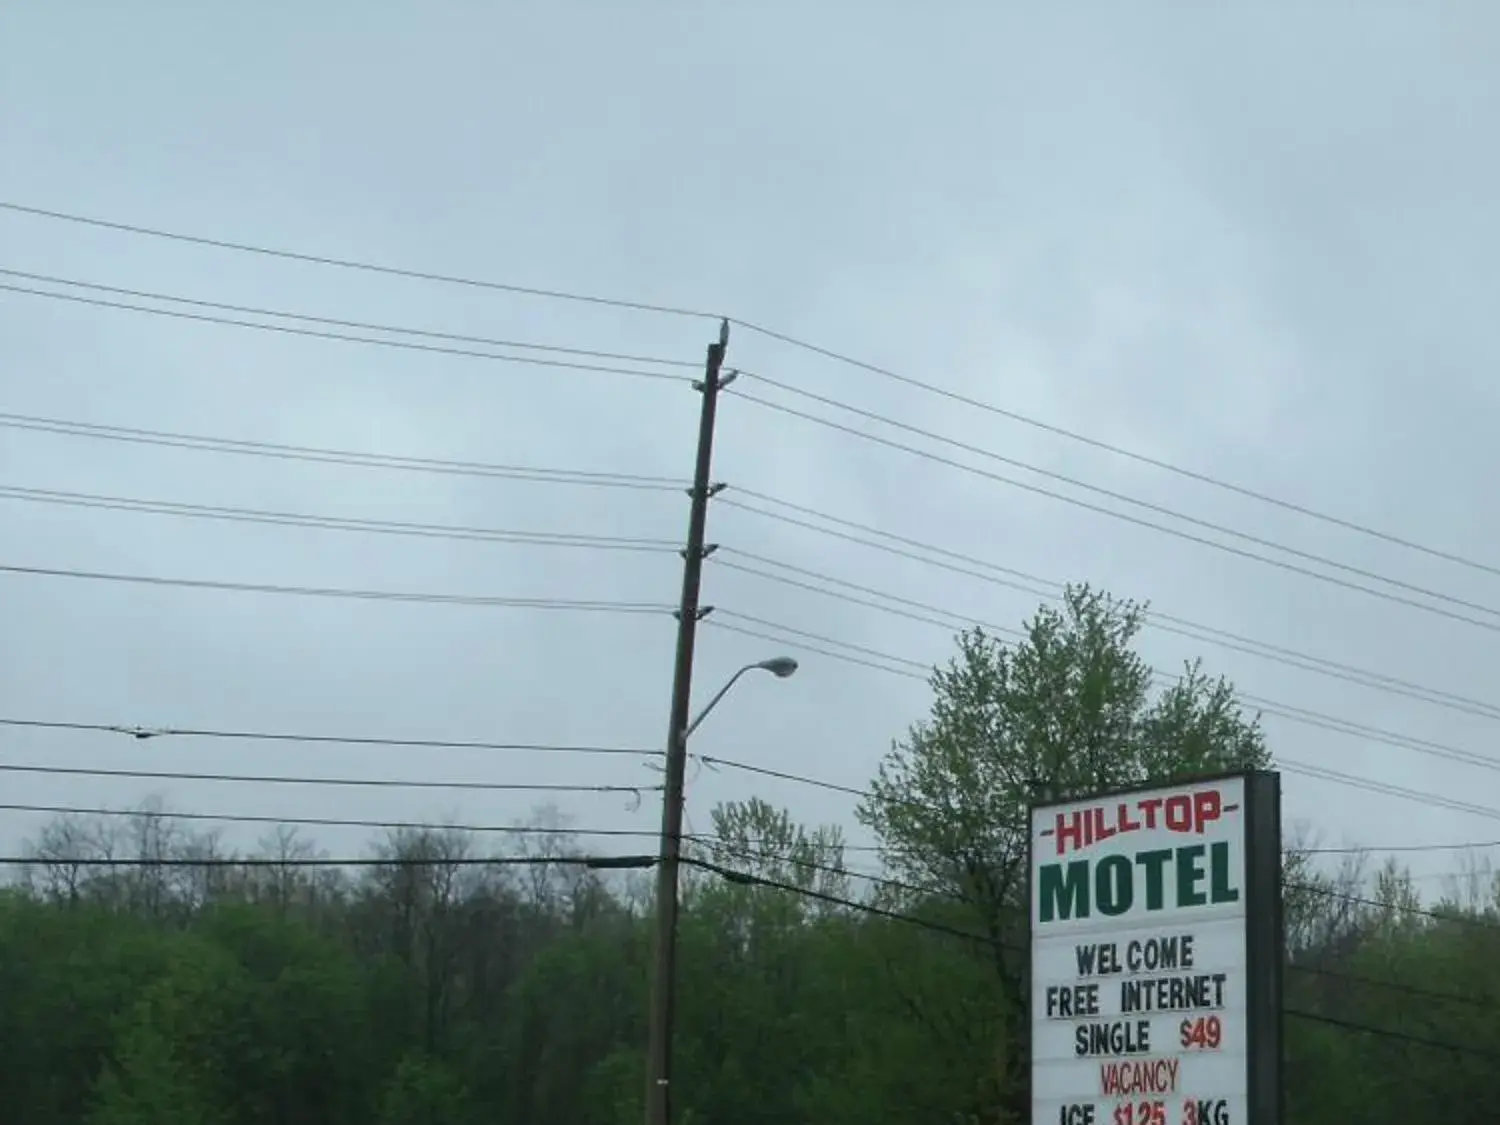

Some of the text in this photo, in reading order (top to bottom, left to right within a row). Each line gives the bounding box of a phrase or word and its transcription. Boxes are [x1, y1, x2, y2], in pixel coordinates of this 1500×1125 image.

[1039, 841, 1239, 923] MOTEL
[1076, 936, 1194, 975] WELCOME
[1047, 974, 1226, 1017] FREE INTERNET
[1076, 1015, 1222, 1056] SINGLE $49
[1101, 1059, 1180, 1095] VACANCY
